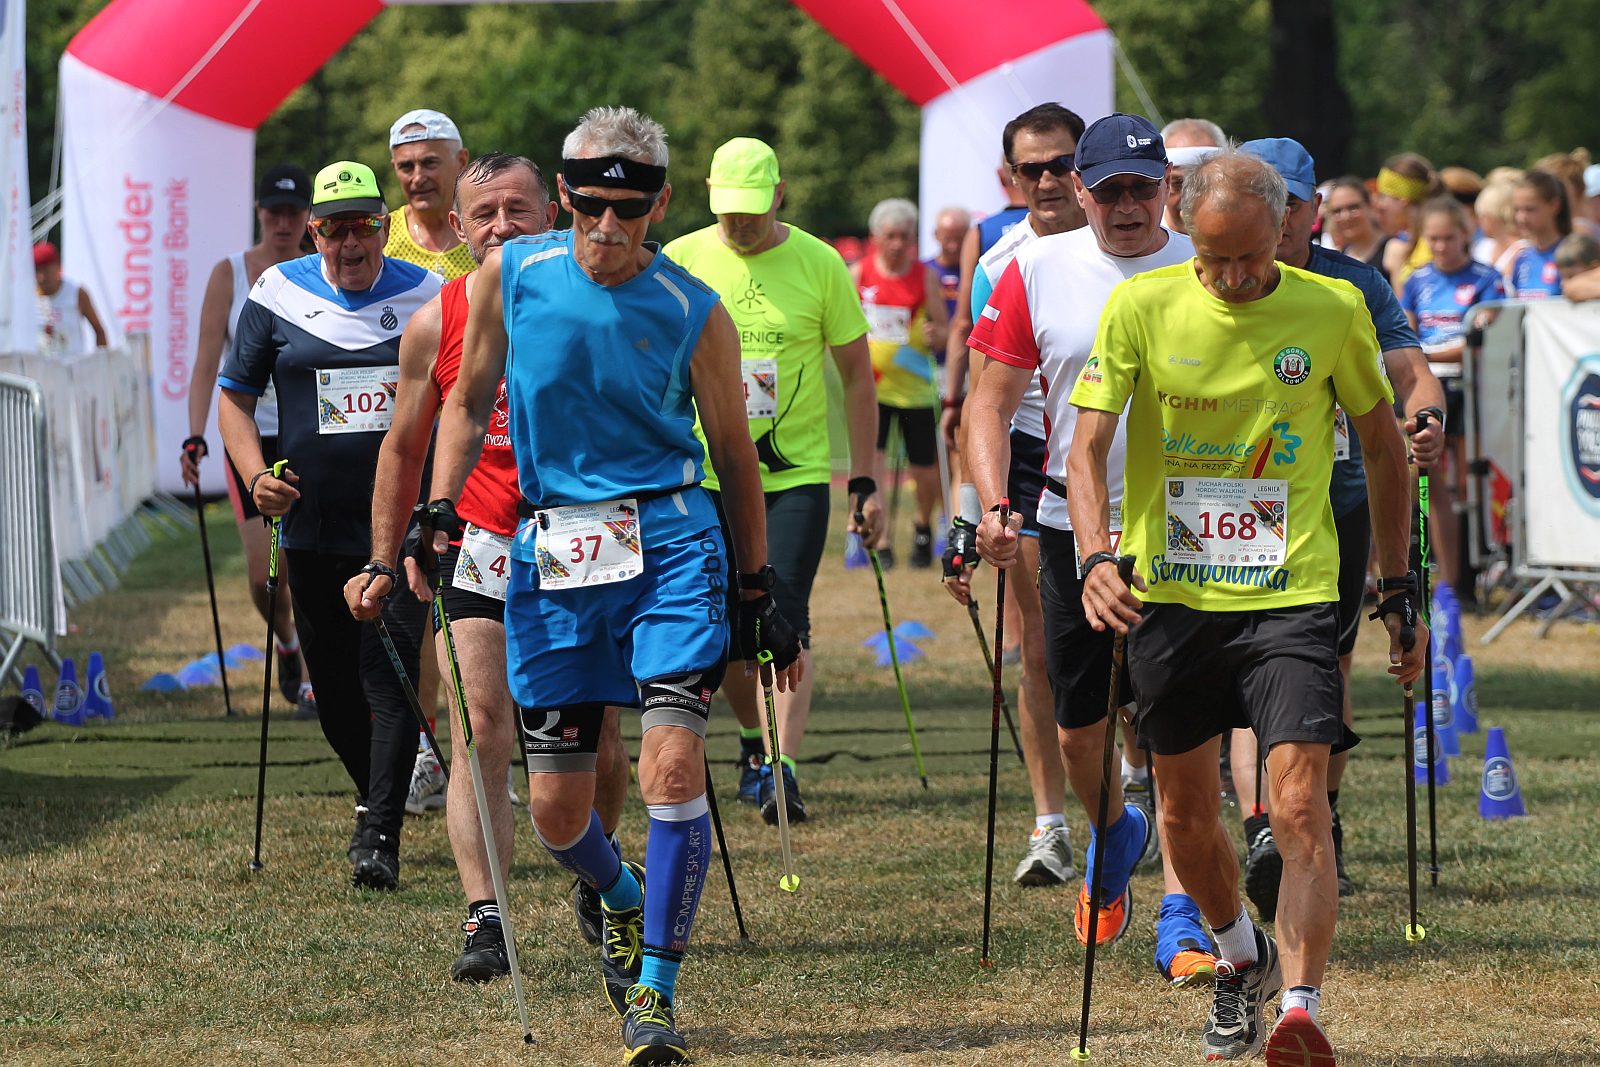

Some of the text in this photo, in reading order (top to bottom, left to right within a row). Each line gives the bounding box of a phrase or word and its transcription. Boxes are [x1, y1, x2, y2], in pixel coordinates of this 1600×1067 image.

[163, 176, 189, 401] Consumer Bank
[1180, 358, 1201, 366] JAKO
[1275, 368, 1309, 385] POLKOWICE
[343, 392, 387, 413] 102
[1157, 390, 1218, 412] KGHM
[1184, 461, 1201, 470] NA
[1257, 485, 1281, 493] LEGNICA
[1199, 511, 1257, 541] 168
[569, 534, 602, 563] 37
